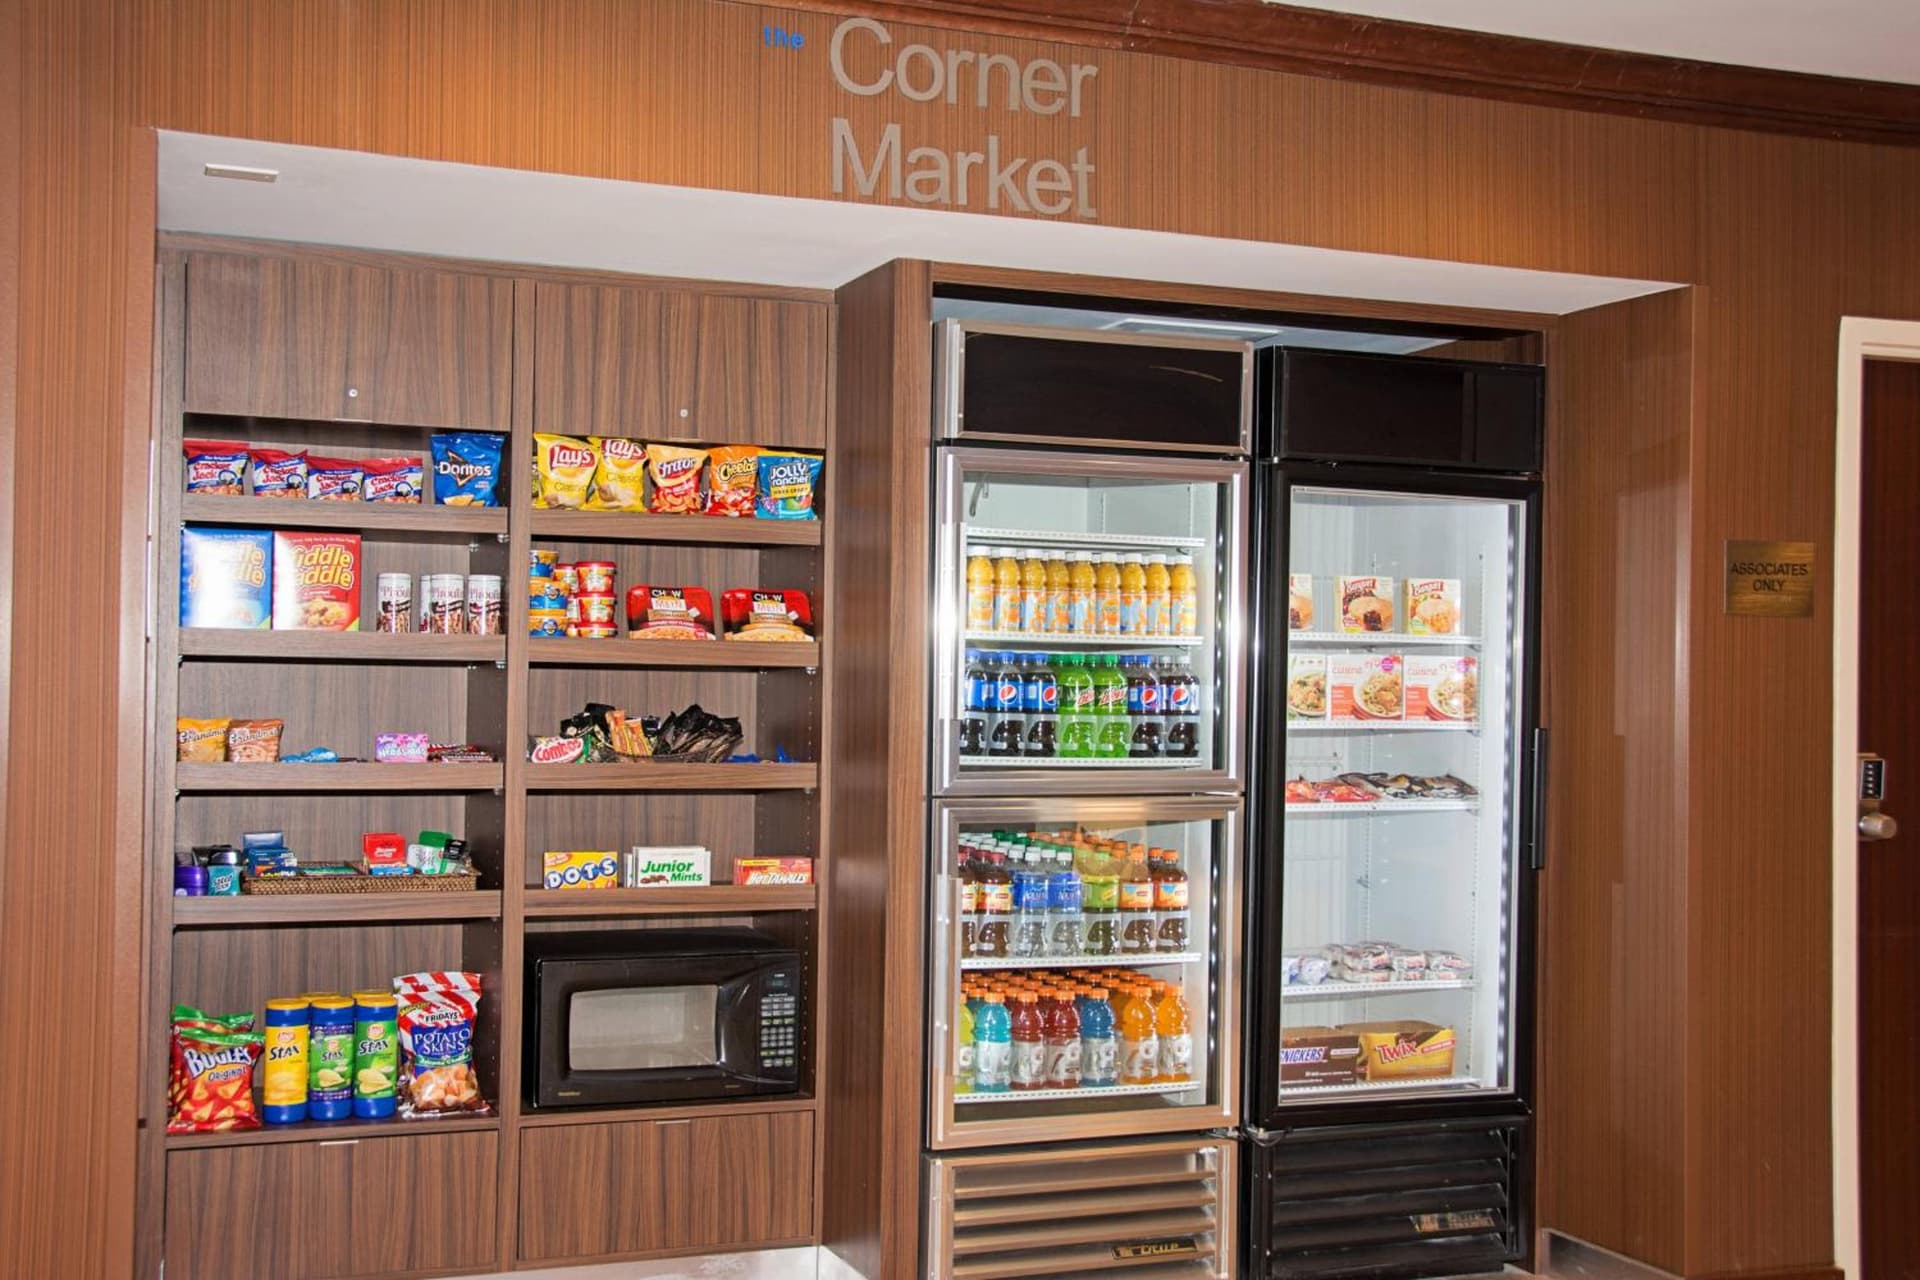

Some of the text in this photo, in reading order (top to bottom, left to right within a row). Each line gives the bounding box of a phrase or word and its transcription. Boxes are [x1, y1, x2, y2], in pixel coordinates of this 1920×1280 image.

[763, 25, 805, 50] the
[830, 17, 1098, 118] Corner
[832, 117, 1096, 219] Market
[439, 462, 492, 477] Doritos
[770, 462, 807, 480] JOLLY
[294, 545, 353, 568] iddle
[1731, 562, 1809, 577] ASSOCIATES
[1752, 578, 1786, 593] ONLY
[533, 736, 582, 762] Combos
[546, 857, 617, 888] DOTS
[641, 860, 695, 874] Junior
[670, 872, 703, 882] Mints
[425, 1012, 458, 1022] FRIDAYS
[414, 1028, 471, 1045] POTATO
[422, 1039, 466, 1055] SKINS
[1375, 1037, 1417, 1064] Twix
[183, 1046, 252, 1079] BUGLES
